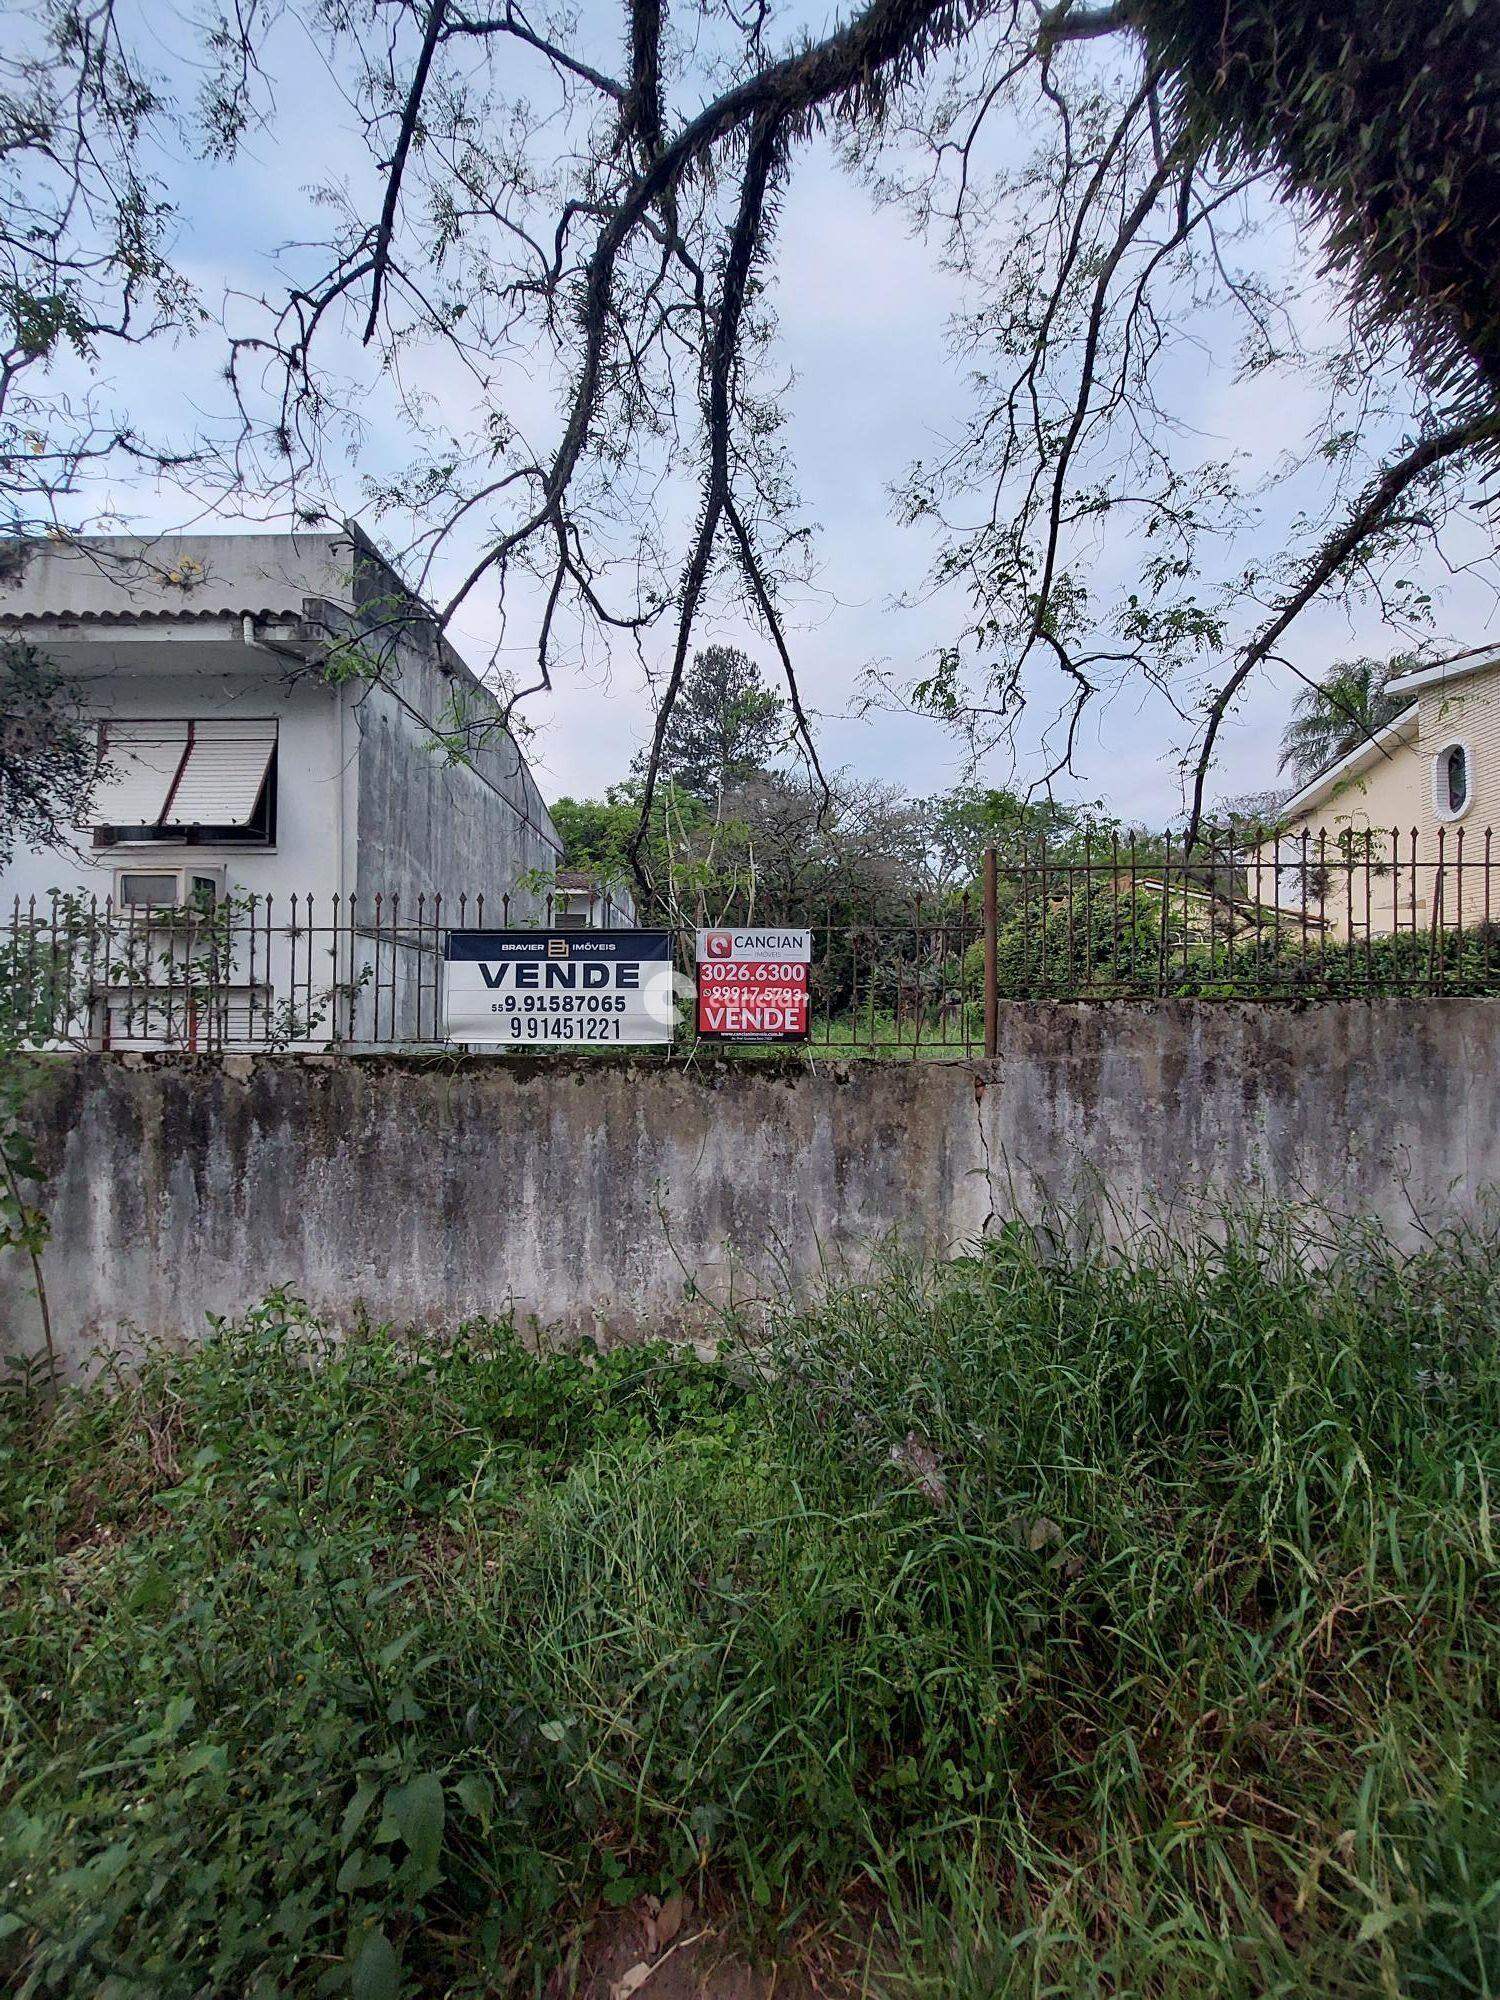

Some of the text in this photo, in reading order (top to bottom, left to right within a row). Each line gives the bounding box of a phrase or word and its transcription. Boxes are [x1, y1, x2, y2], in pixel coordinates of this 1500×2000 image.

[501, 942, 617, 952] BRAVIER IMÓVEIS
[734, 936, 803, 949] CANCIAN
[478, 962, 641, 989] VENDE
[701, 964, 805, 981] 3026.6300
[527, 1016, 620, 1039] 91451221
[705, 1008, 800, 1030] VENDE
